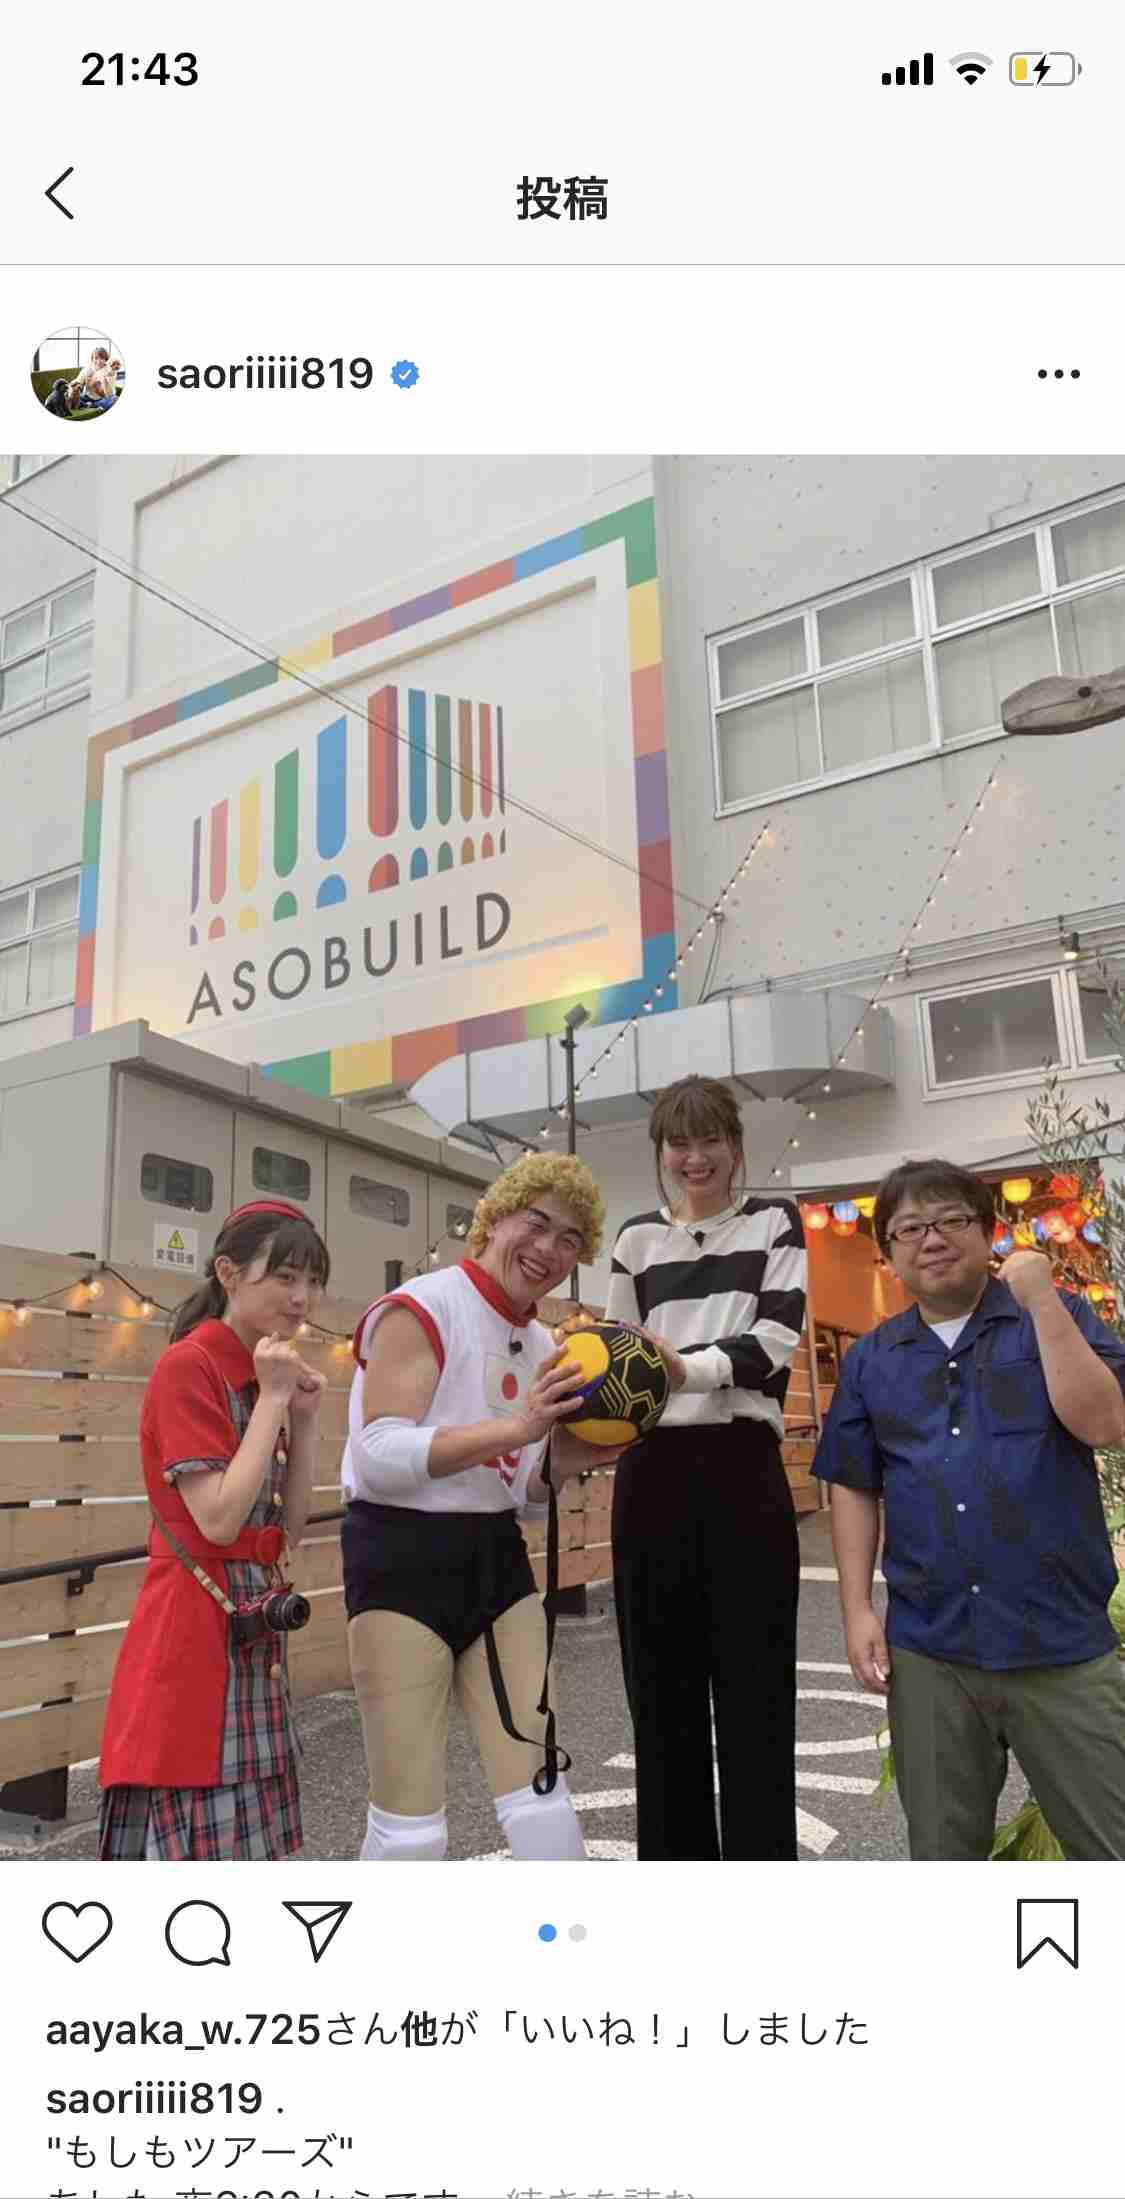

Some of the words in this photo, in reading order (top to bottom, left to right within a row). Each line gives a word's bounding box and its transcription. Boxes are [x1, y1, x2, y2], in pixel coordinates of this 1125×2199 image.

[79, 51, 199, 88] 21:43
[515, 174, 609, 221] 投稿
[157, 354, 374, 392] saoriiiii819
[186, 892, 512, 1024] ASOBUILD
[46, 2080, 263, 2115] saoriiiii819
[47, 2132, 353, 2169] "もしもツアーズ"
